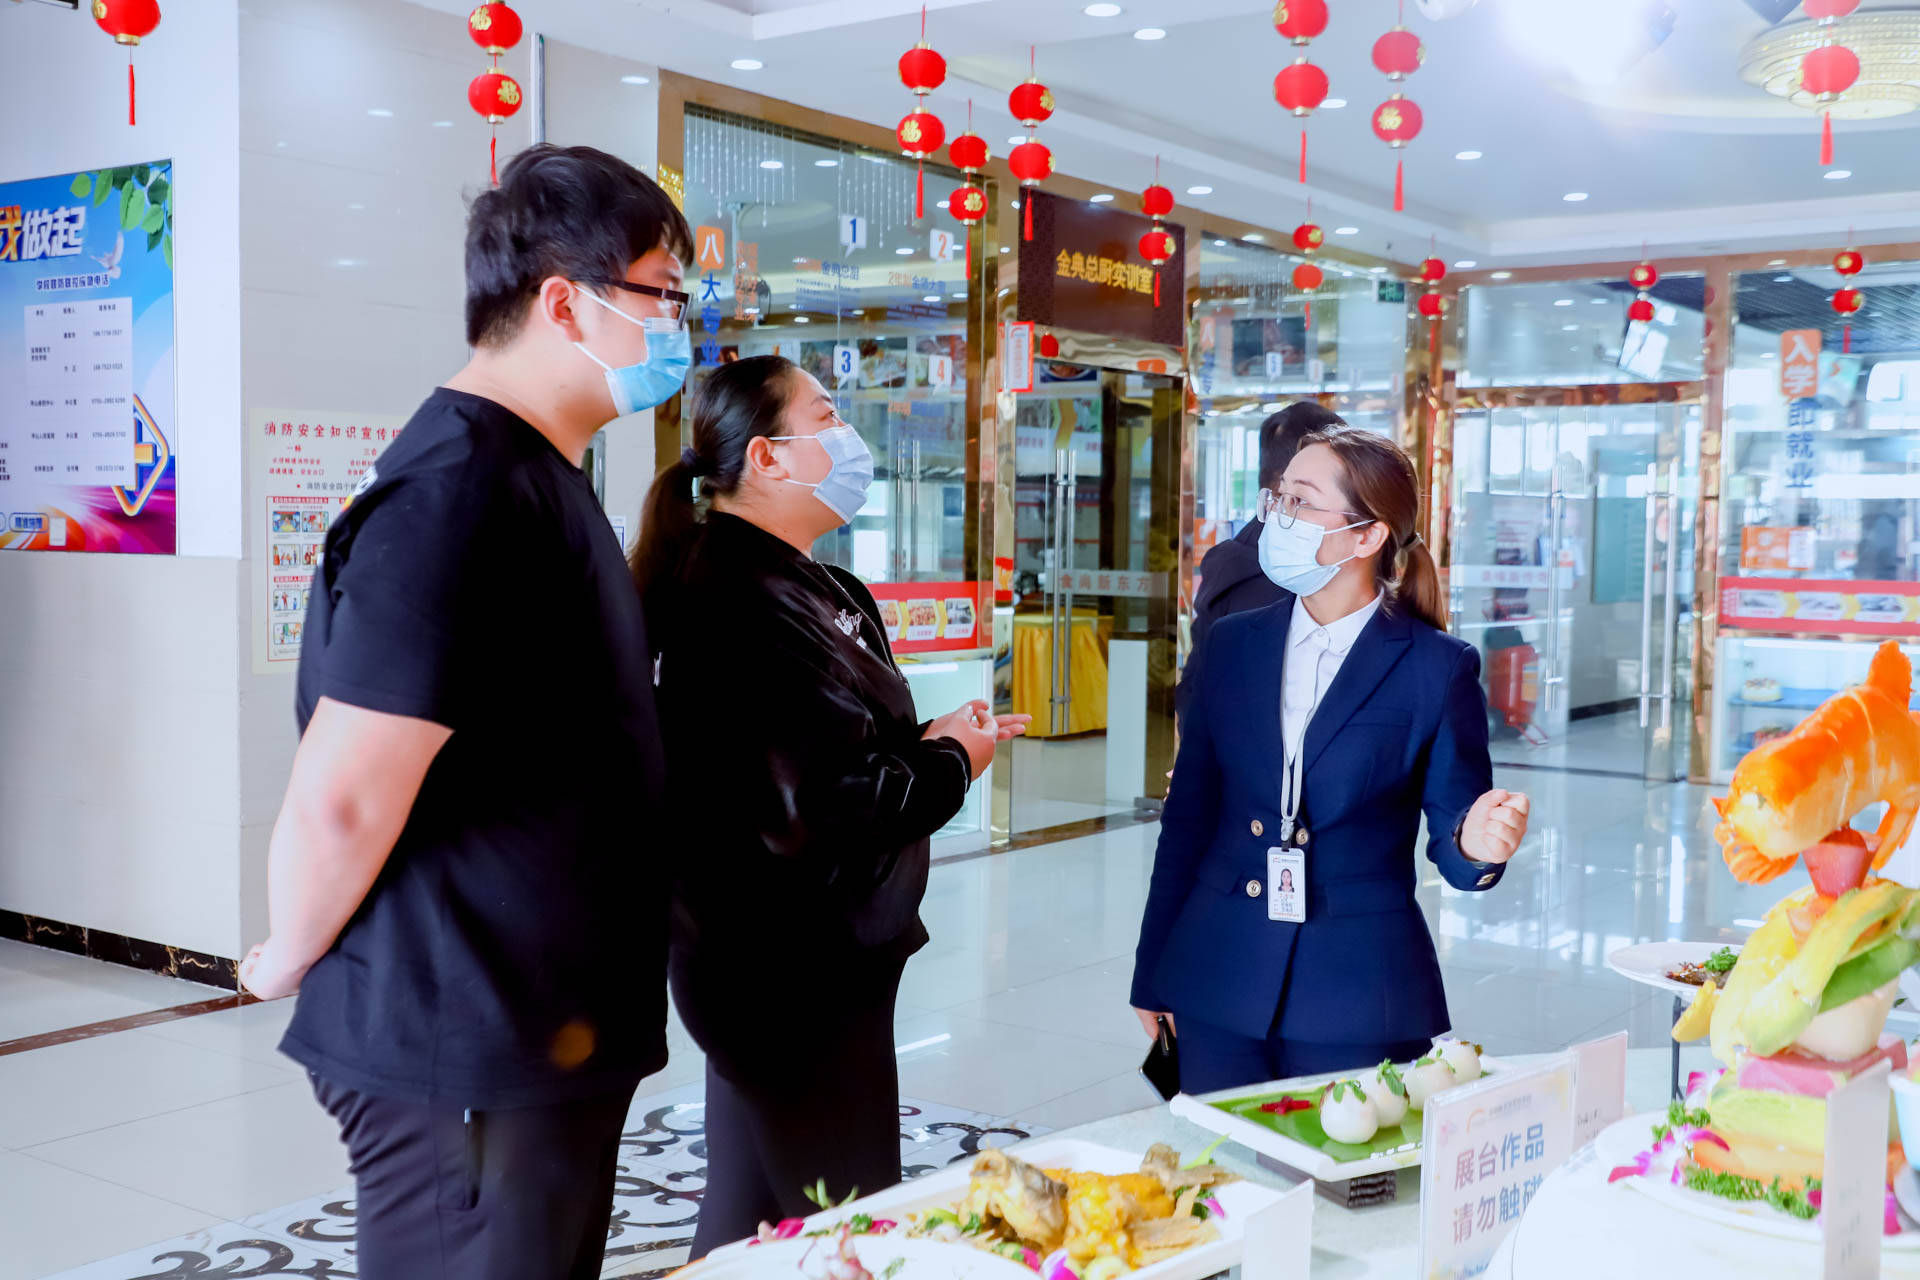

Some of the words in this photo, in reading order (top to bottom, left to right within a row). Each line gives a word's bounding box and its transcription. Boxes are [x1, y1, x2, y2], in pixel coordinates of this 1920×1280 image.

[850, 218, 856, 243] 1
[938, 233, 946, 259] 2
[1056, 248, 1152, 294] 金典总厨实训室
[841, 351, 850, 373] 3
[937, 359, 945, 381] 4
[1454, 1122, 1545, 1191] 展台作品
